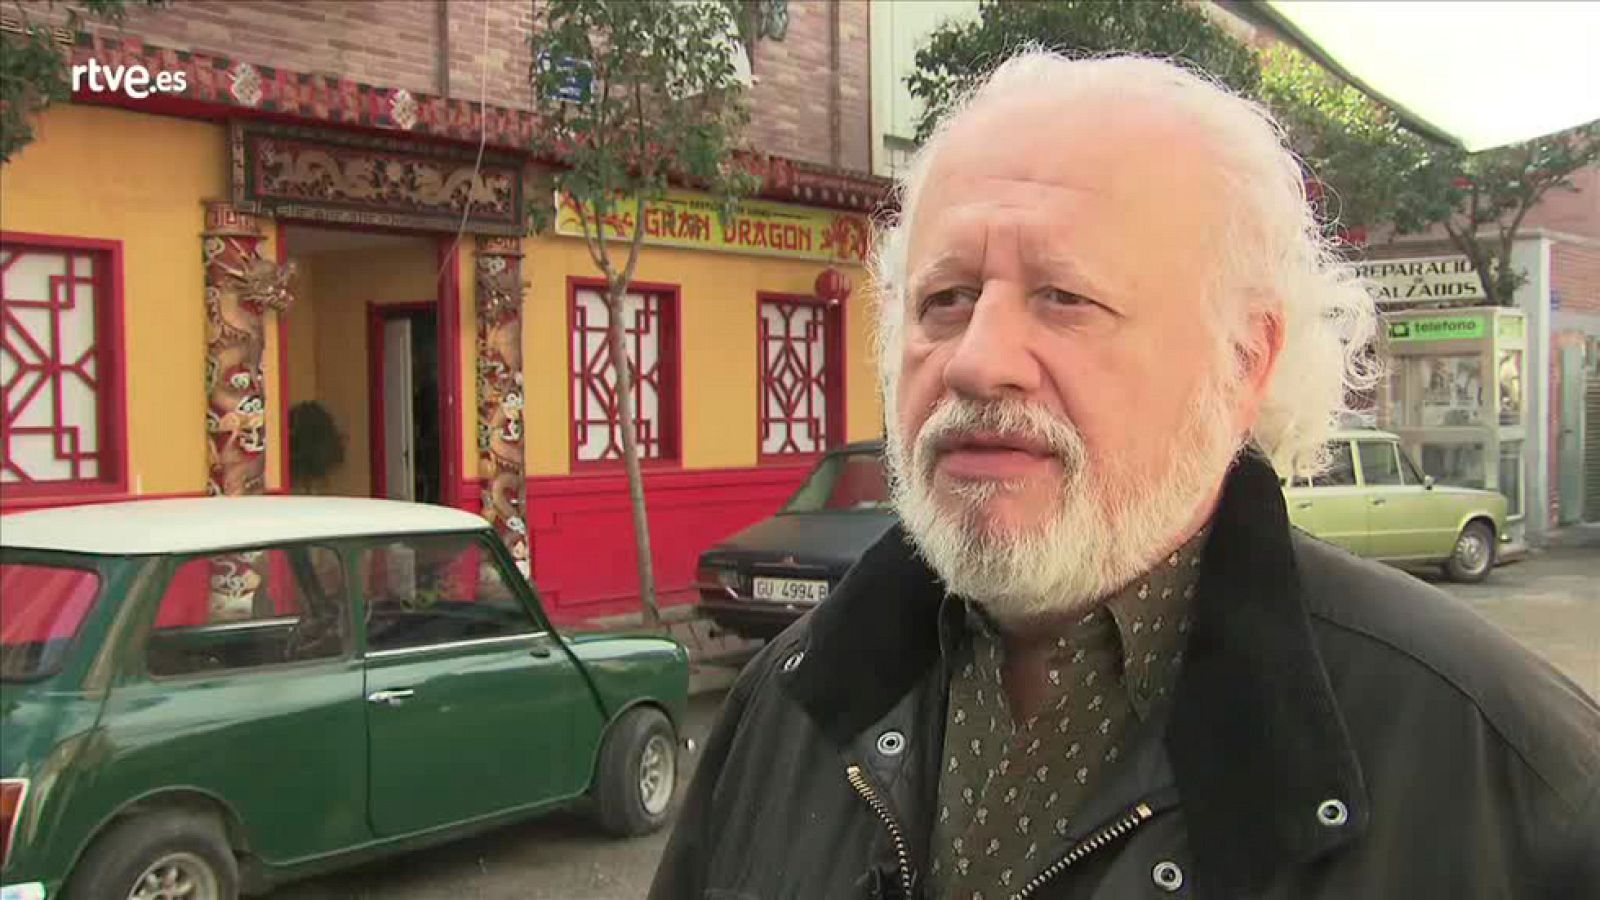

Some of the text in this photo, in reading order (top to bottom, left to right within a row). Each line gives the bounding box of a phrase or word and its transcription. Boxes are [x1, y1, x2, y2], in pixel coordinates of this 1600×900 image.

[645, 207, 710, 241] GRAN
[723, 216, 812, 251] DRAGON
[1355, 260, 1475, 278] REPARACIO
[757, 580, 774, 596] GU
[781, 582, 814, 599] 4994
